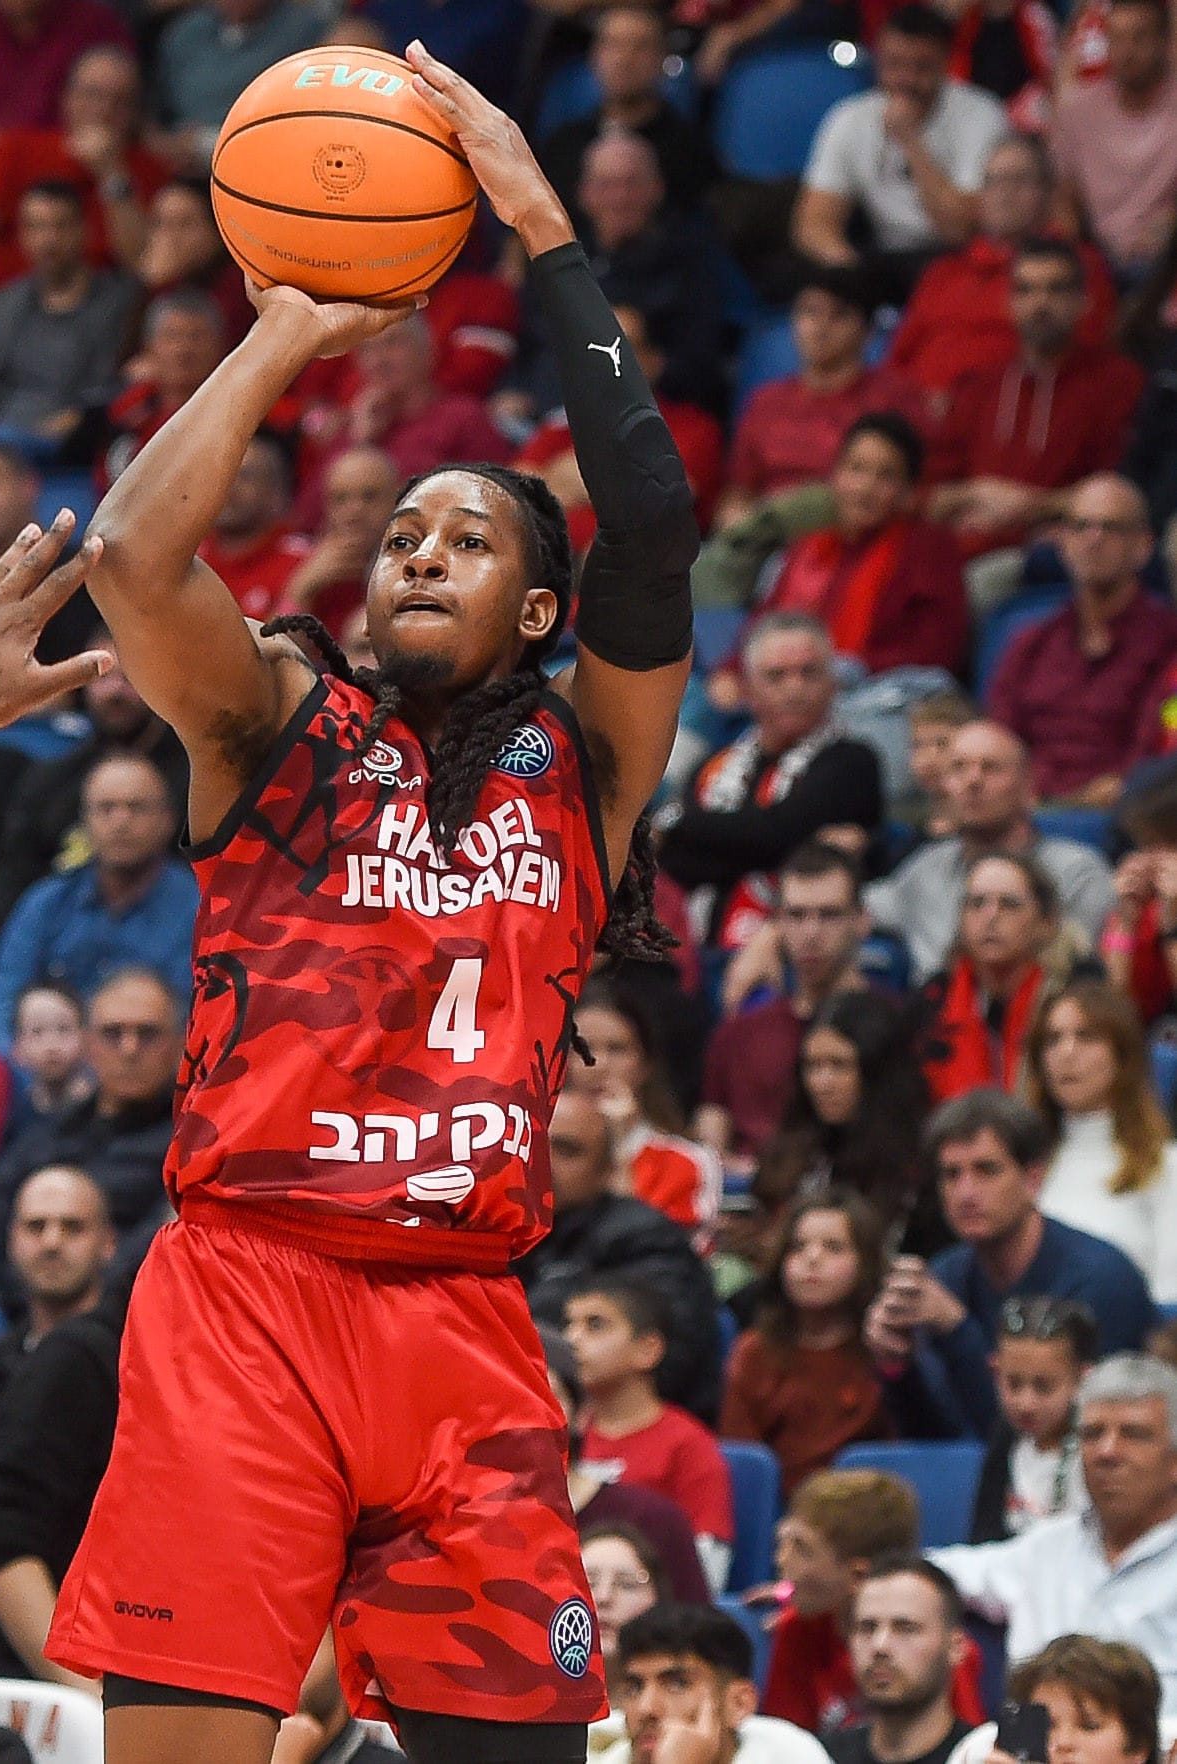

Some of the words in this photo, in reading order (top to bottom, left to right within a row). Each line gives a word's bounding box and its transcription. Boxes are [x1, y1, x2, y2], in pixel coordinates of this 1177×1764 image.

[295, 64, 404, 96] EVO
[377, 798, 542, 869] HAOEL
[341, 850, 561, 918] JERUSALEM
[427, 958, 485, 1063] 4
[309, 1110, 440, 1162] יהב
